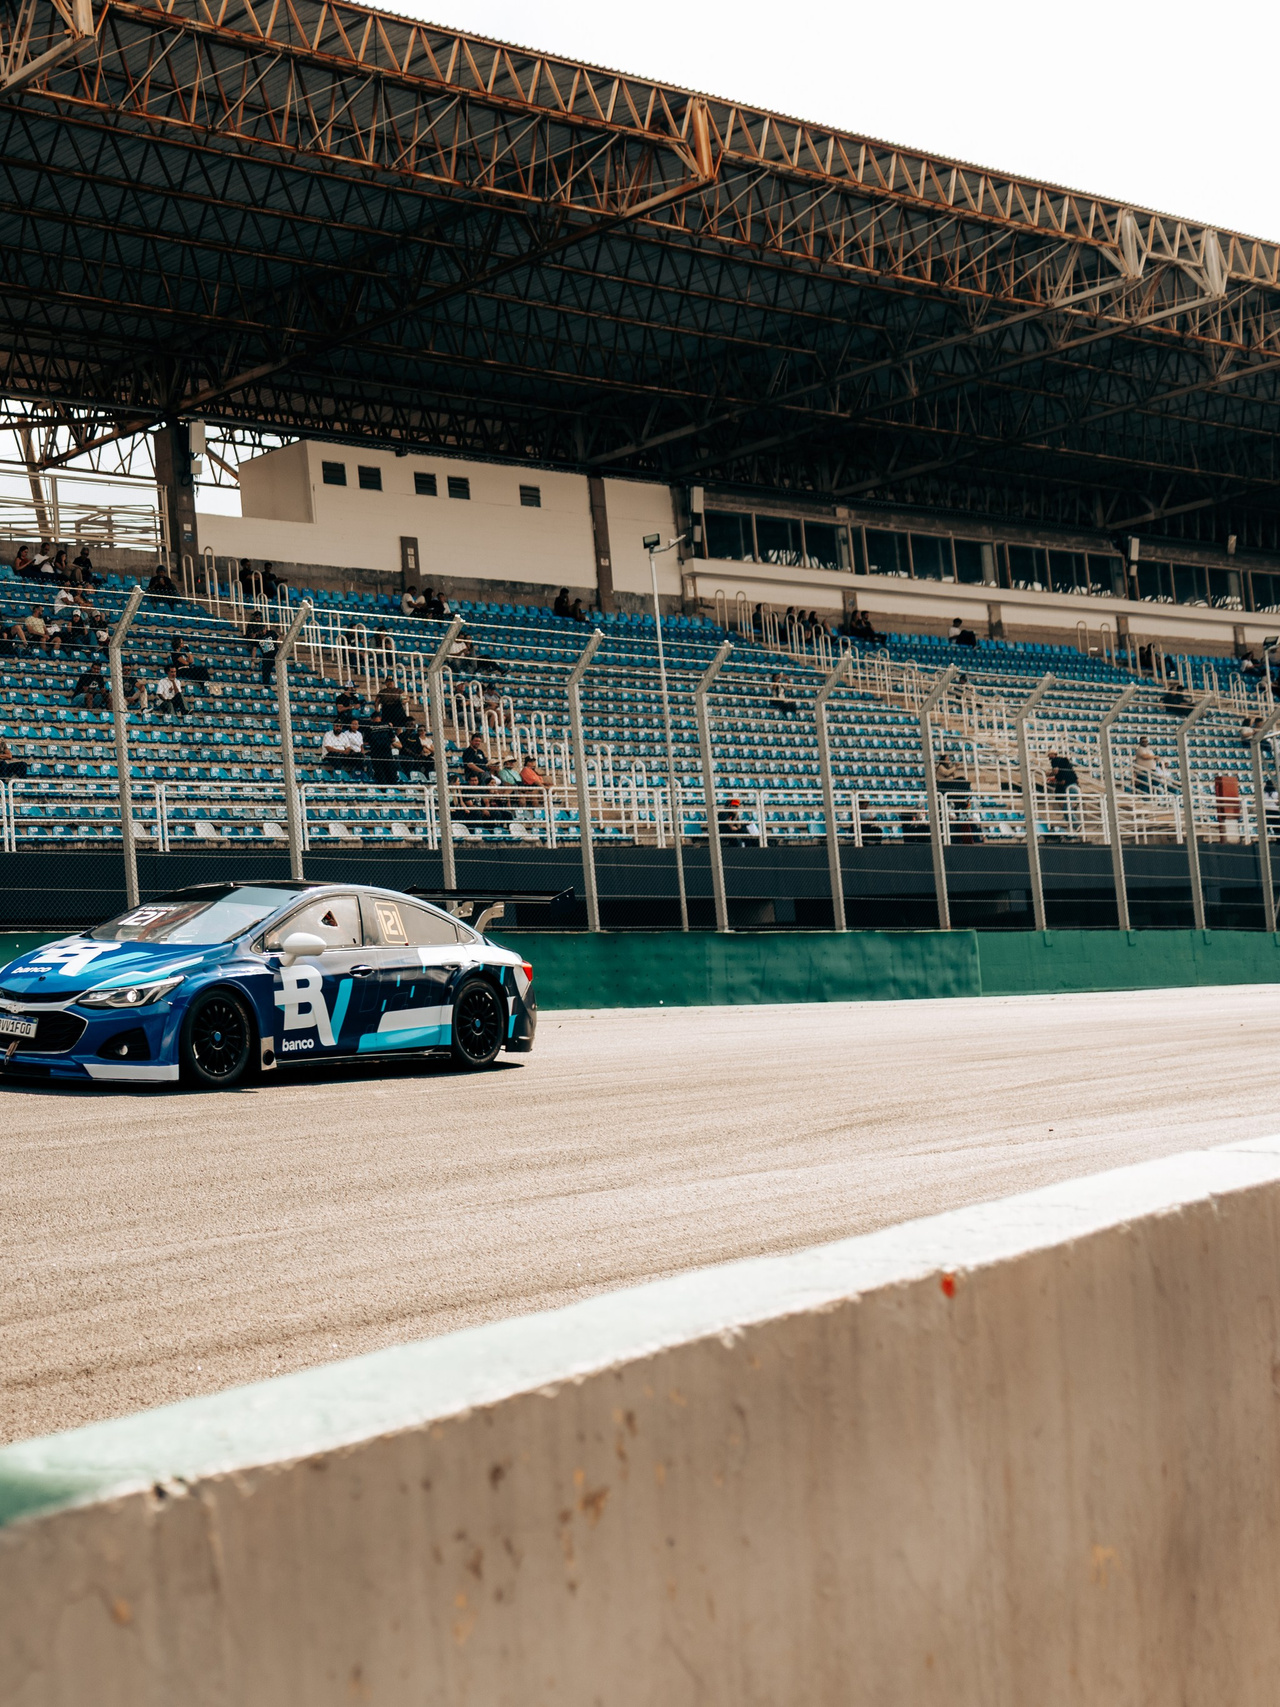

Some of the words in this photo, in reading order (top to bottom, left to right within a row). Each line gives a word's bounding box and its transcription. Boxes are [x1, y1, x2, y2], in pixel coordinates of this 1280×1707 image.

[117, 911, 167, 926] 121
[376, 909, 404, 936] 121
[11, 966, 52, 974] banco
[282, 1038, 315, 1052] banco
